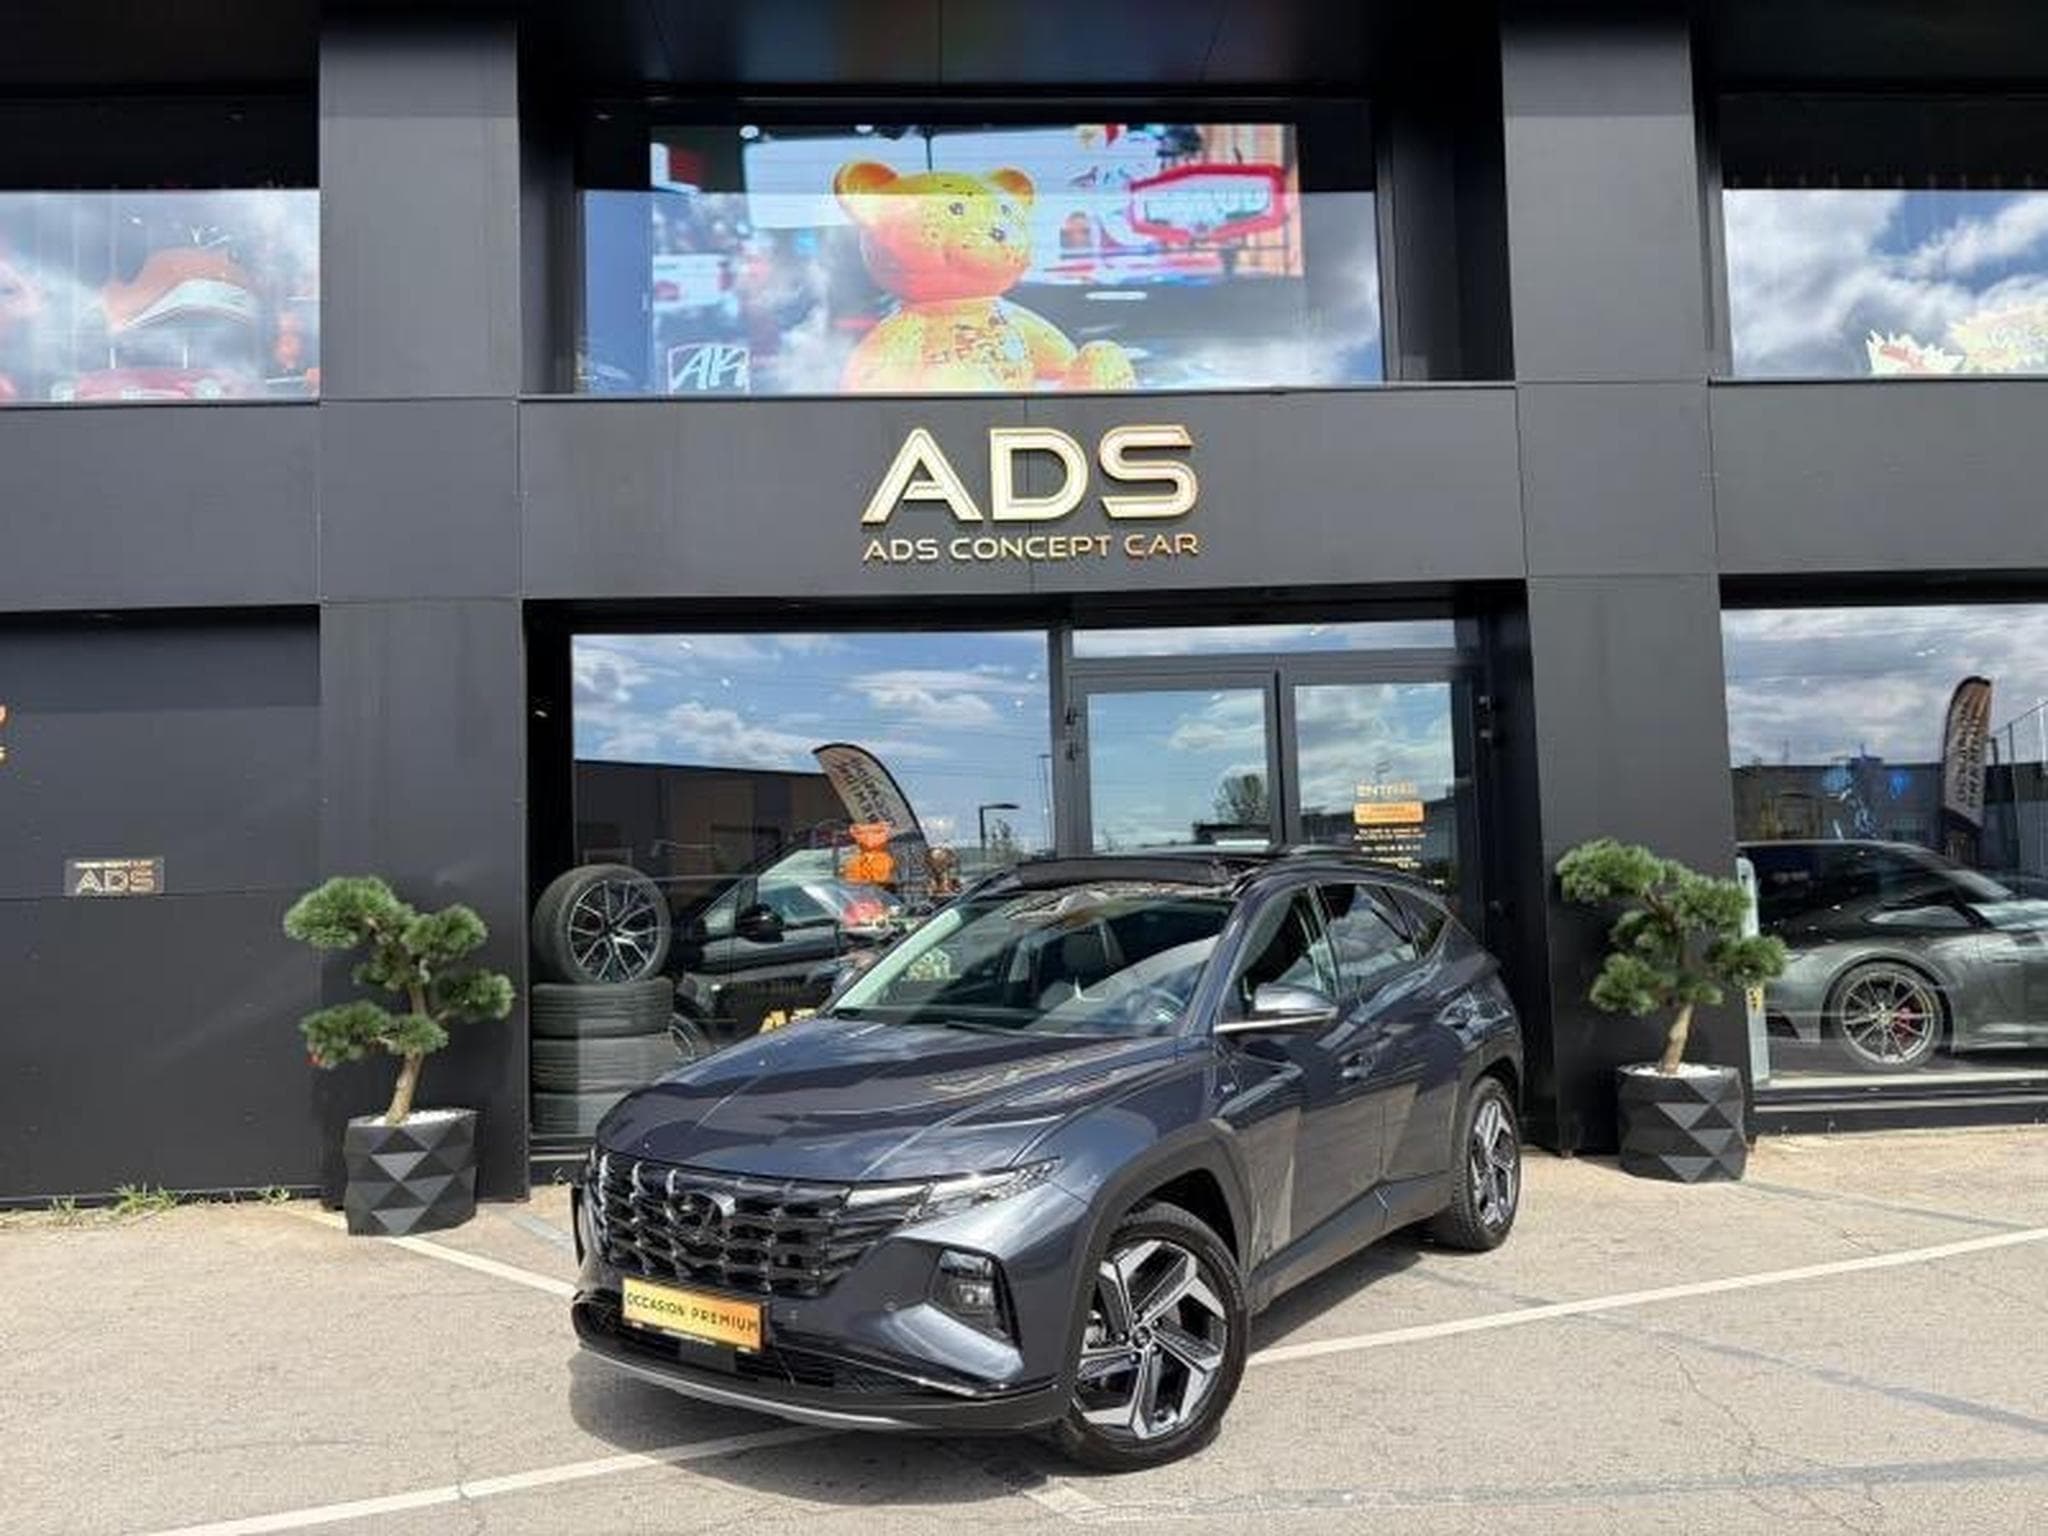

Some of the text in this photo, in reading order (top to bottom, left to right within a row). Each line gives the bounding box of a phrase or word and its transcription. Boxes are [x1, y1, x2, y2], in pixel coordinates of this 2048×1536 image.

[861, 425, 1198, 523] ADS
[863, 533, 1200, 561] ADS CONCEPT CAR
[76, 868, 154, 894] ADS
[626, 1292, 759, 1334] OCCASION PREMIUM
